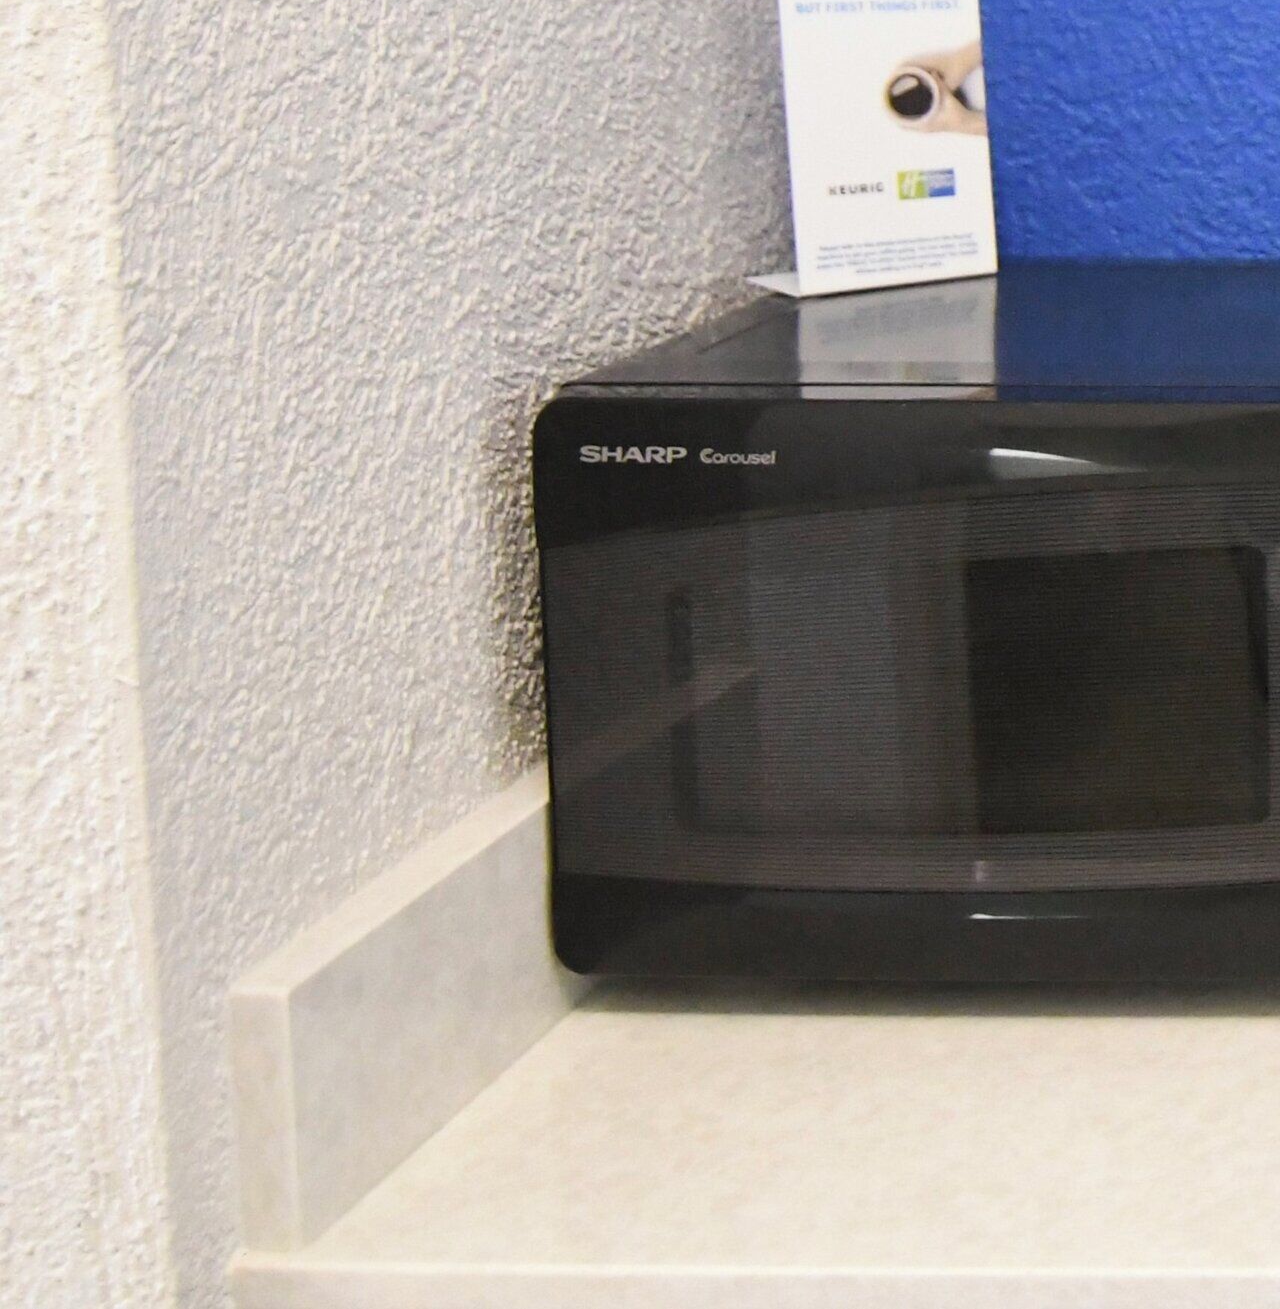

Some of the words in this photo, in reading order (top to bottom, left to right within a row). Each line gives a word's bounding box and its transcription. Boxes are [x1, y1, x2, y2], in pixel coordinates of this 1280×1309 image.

[829, 182, 884, 195] KEURIG
[579, 445, 688, 463] SHARP
[699, 448, 777, 465] Carousel
